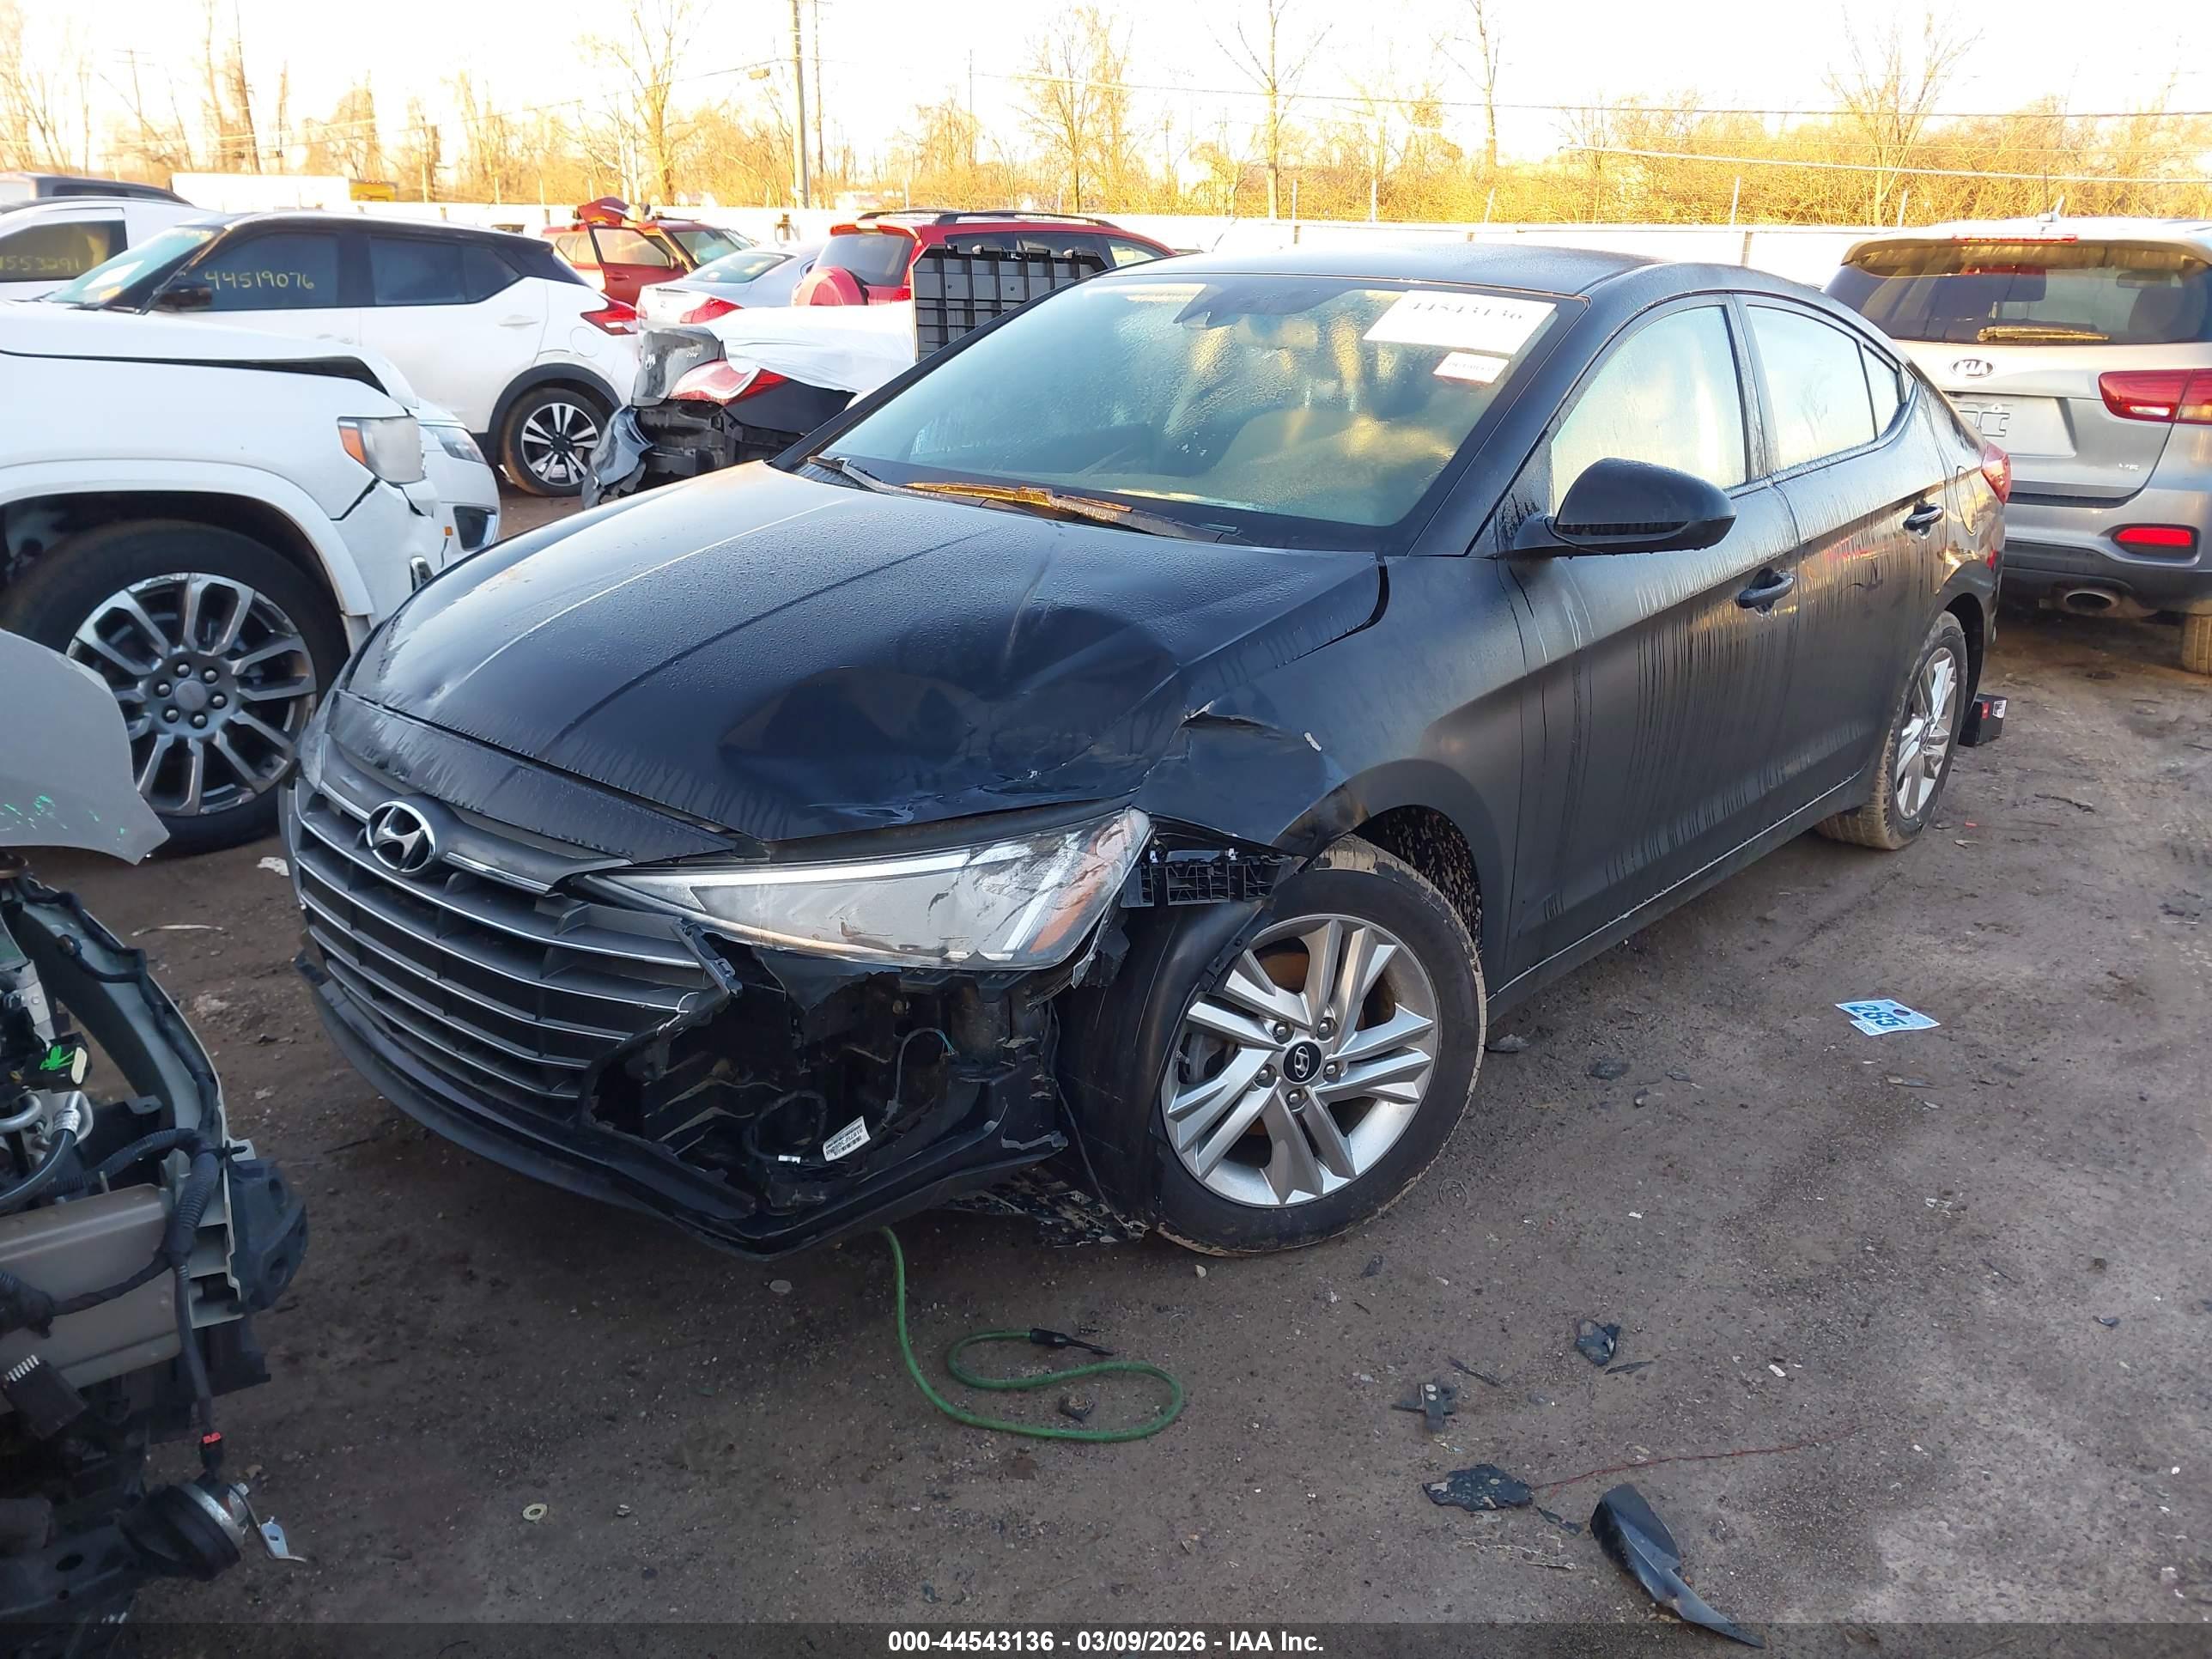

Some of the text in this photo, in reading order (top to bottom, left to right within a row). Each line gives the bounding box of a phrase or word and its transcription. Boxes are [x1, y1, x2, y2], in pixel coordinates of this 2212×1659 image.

[204, 270, 315, 290] 44519076
[1954, 359, 1990, 376] KIA
[1846, 1004, 1910, 1028] 285
